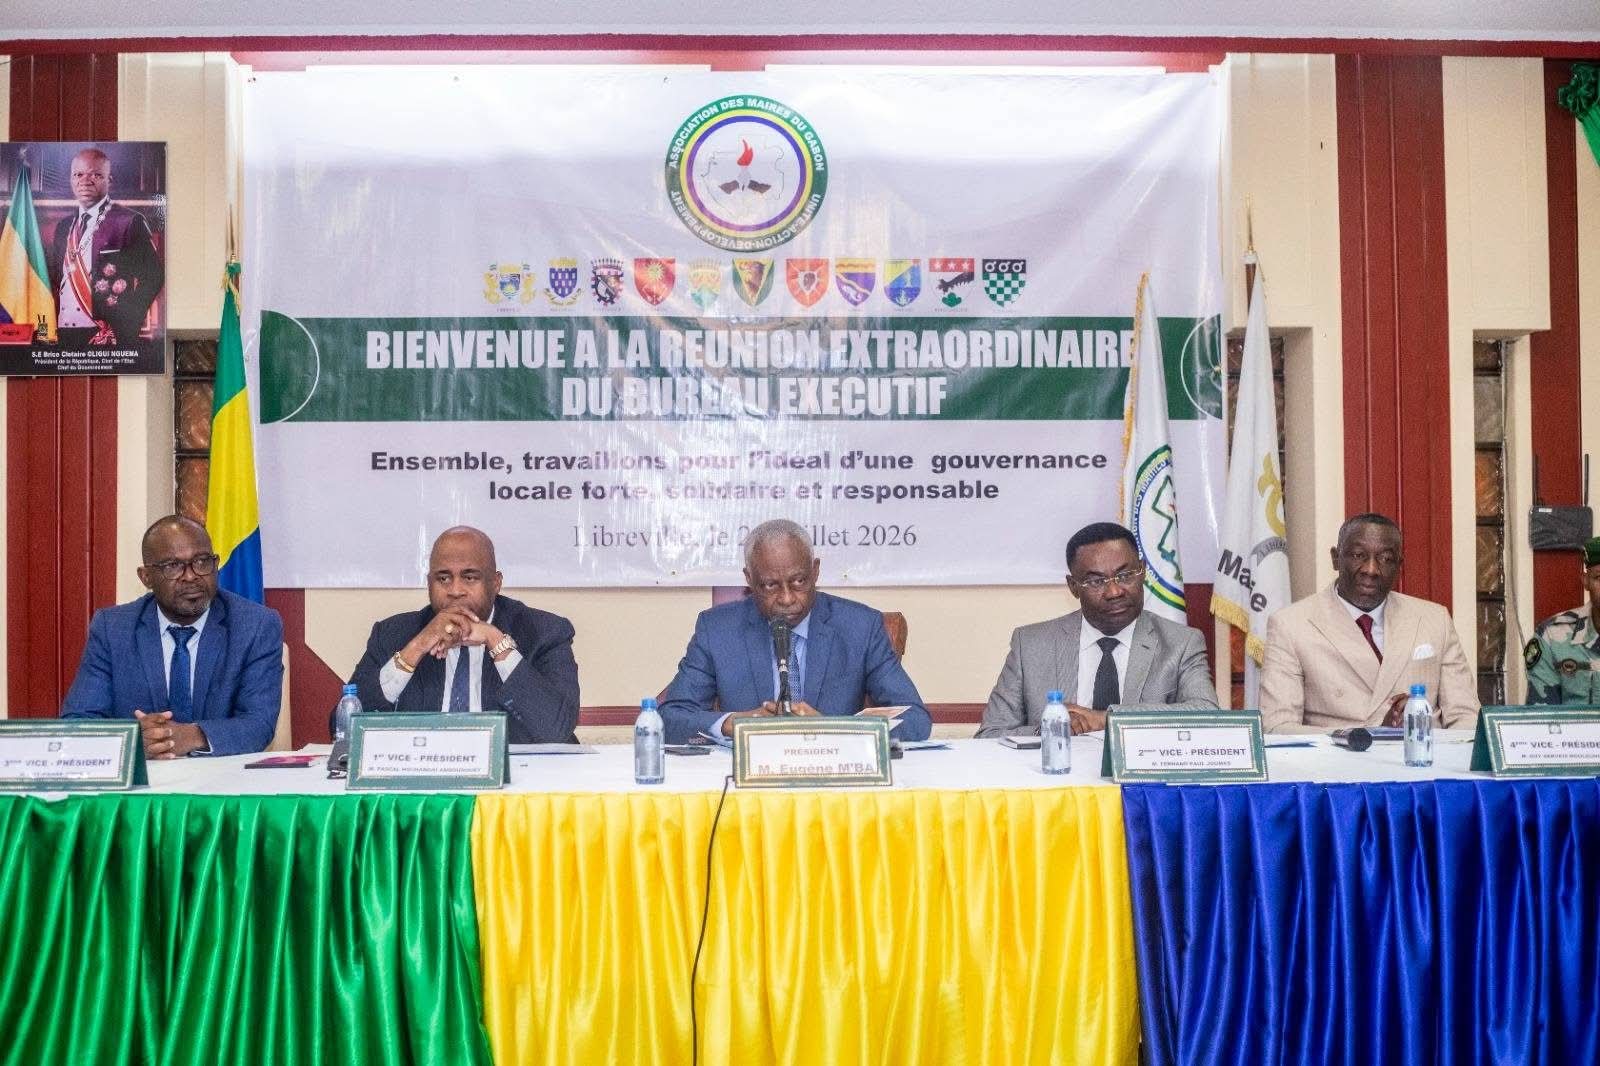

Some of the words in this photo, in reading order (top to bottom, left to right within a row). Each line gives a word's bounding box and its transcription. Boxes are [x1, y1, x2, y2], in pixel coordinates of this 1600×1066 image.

[668, 104, 719, 168] ASSOCIATION
[720, 97, 744, 110] DES
[747, 98, 792, 118] MAIRES
[791, 115, 808, 131] DU
[804, 131, 825, 171] GABON
[366, 330, 565, 369] BIENVENUE
[573, 330, 599, 368] A
[607, 330, 651, 368] LA
[659, 329, 820, 368] REUNION
[562, 377, 612, 416] DU
[623, 377, 769, 416] BUREAU
[780, 376, 946, 415] EXECUTIF
[371, 452, 513, 474] Ensemble,
[522, 451, 667, 470] travaillons
[679, 455, 740, 474] pour
[840, 451, 913, 470] d'une
[931, 454, 1108, 473] gouvernance
[489, 481, 572, 500] locale
[665, 481, 786, 500] solidaire
[795, 481, 823, 500] et
[832, 480, 1000, 503] responsable
[857, 525, 917, 546] 2026
[25, 759, 48, 767] VICE
[838, 763, 874, 773] M'BA
